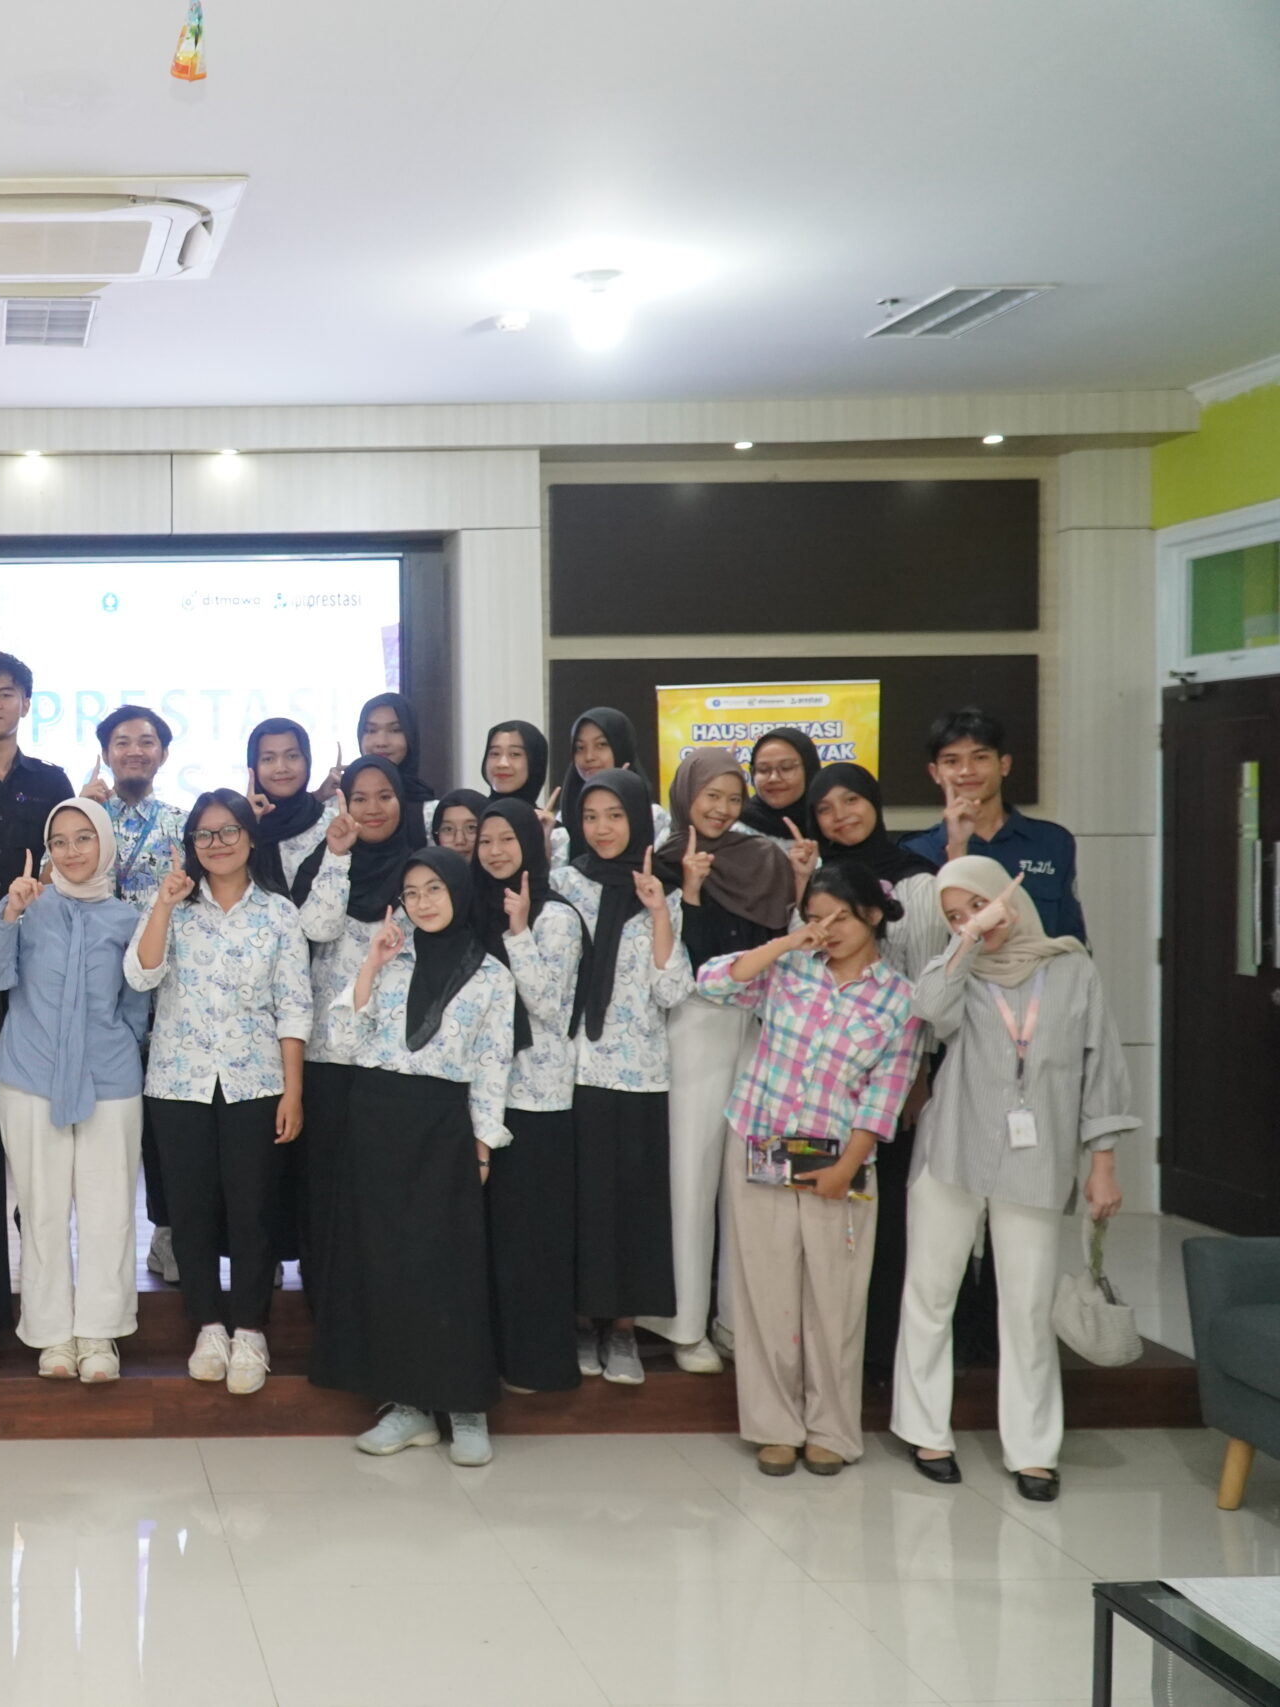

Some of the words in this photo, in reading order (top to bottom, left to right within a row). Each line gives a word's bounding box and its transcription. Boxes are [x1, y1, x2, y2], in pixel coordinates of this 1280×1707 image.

[30, 689, 338, 743] PRSTASI
[692, 723, 747, 741] HAUS
[750, 721, 842, 740] PRTASI
